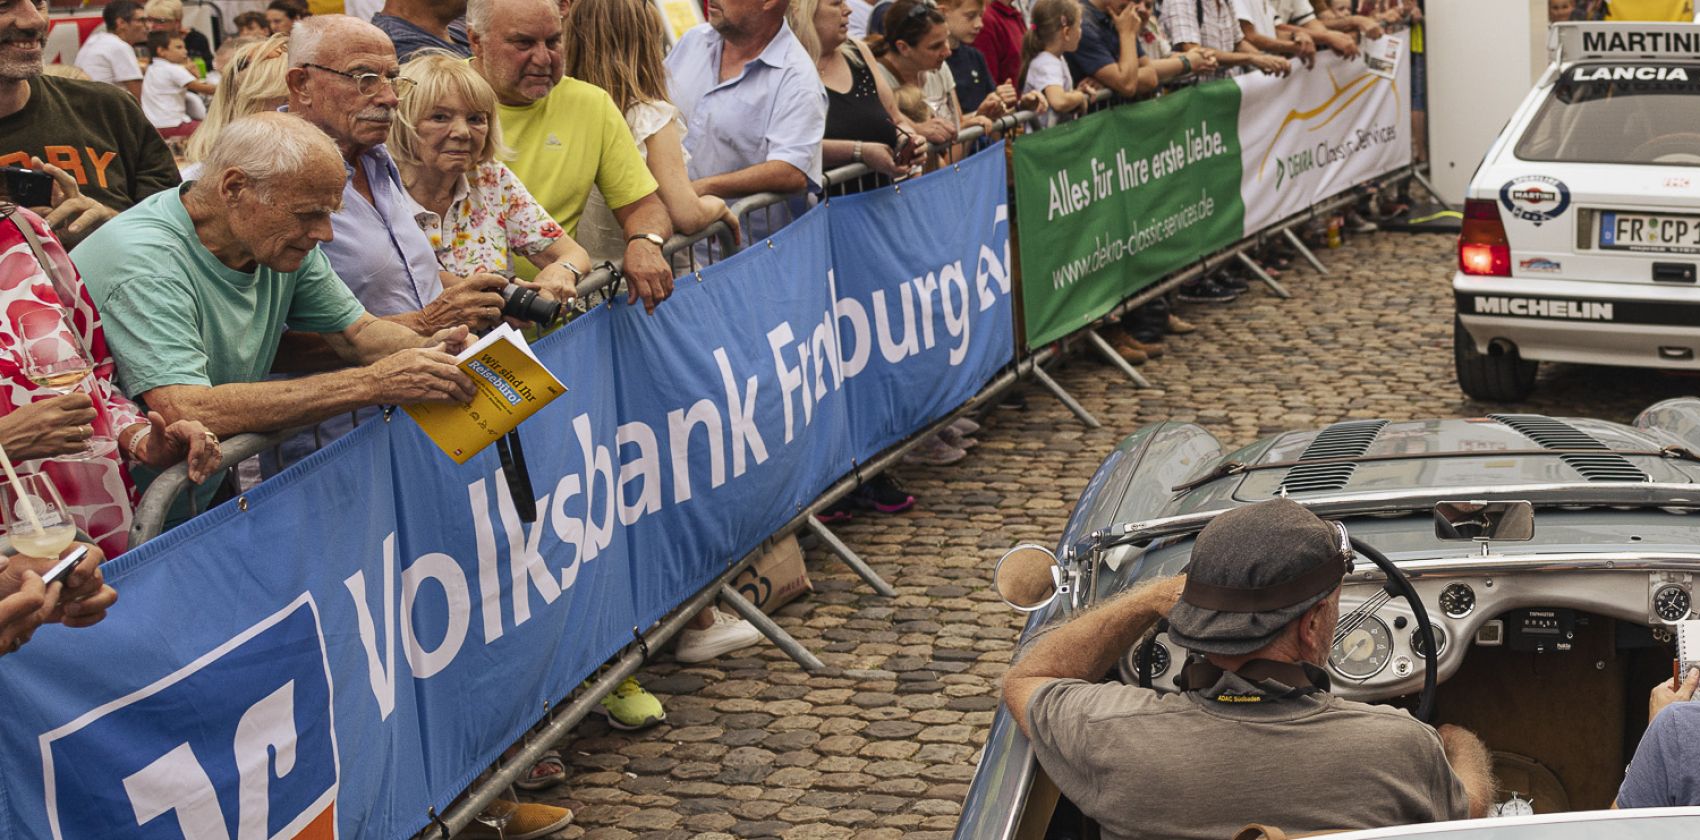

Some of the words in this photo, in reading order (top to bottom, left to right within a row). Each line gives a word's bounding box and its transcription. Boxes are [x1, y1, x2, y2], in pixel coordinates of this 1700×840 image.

[1582, 31, 1700, 53] MARTINI
[1573, 66, 1689, 82] LANCIA
[1048, 167, 1091, 221] Alles
[1091, 157, 1114, 202] für
[1116, 147, 1150, 192] Ihre
[1151, 140, 1185, 180] erste
[1185, 120, 1228, 165] Liebe.
[1052, 187, 1215, 290] www.dekra-classic-services.de
[1616, 217, 1644, 242] FR
[1661, 219, 1689, 244] CP
[1474, 296, 1613, 320] MICHELIN
[468, 360, 523, 406] Reisebüro!
[480, 353, 503, 372] Wir
[499, 367, 524, 390] sind
[519, 385, 538, 403] Ihr
[343, 346, 769, 722] Volksbank
